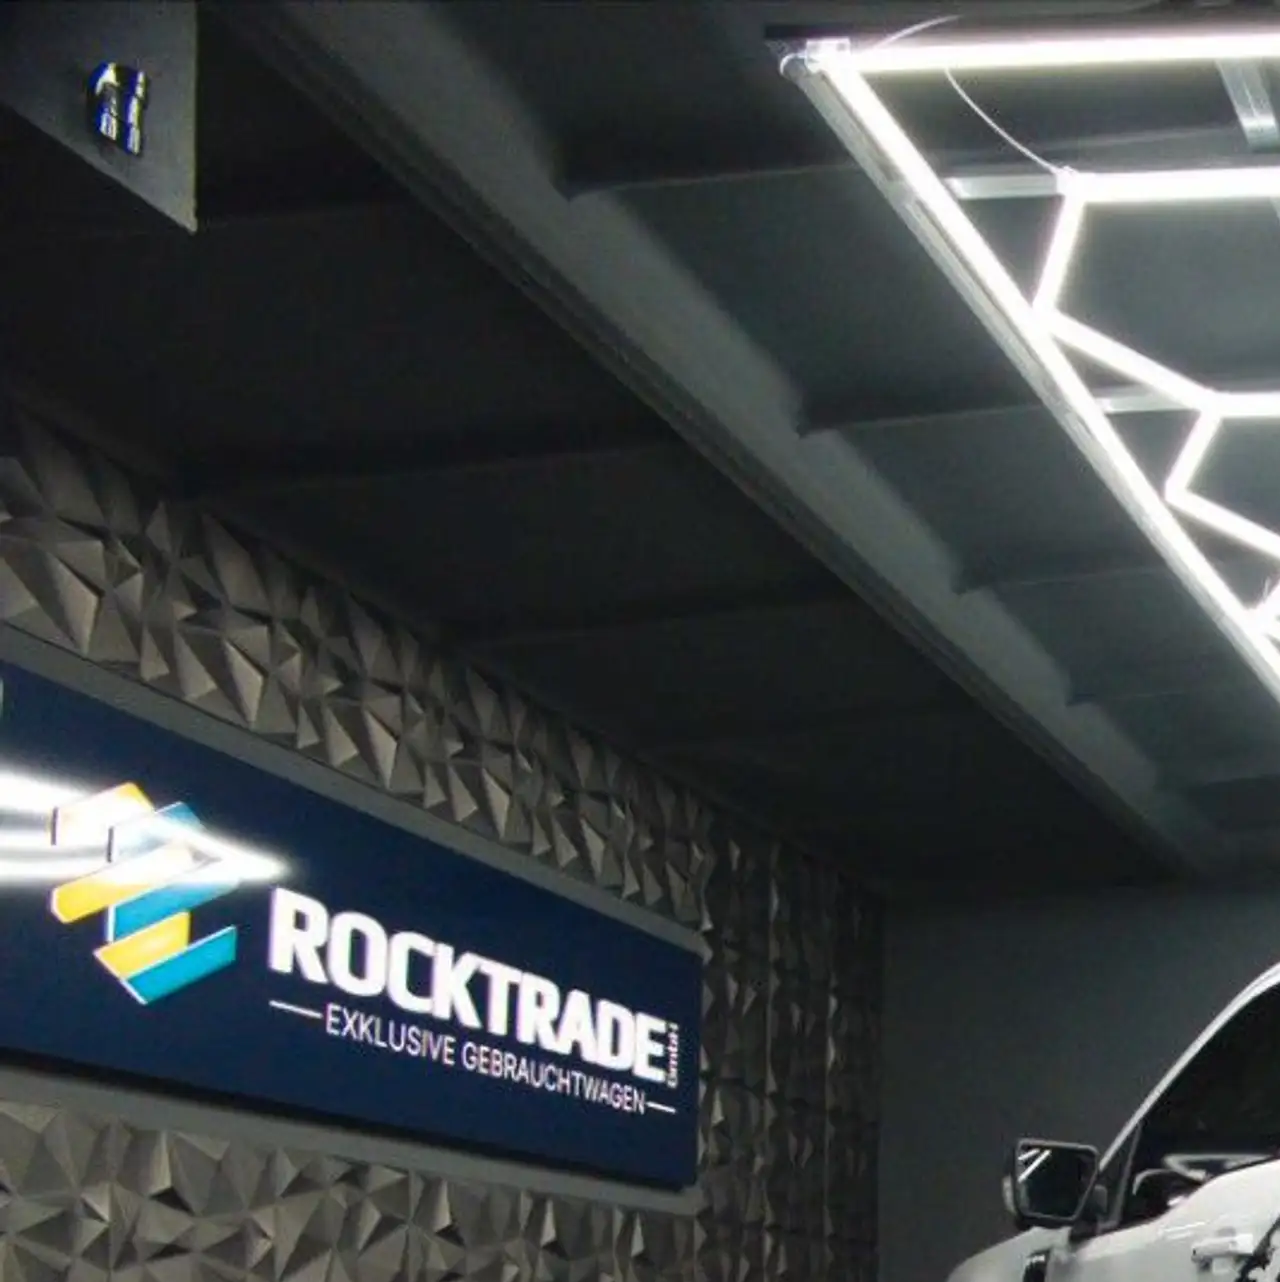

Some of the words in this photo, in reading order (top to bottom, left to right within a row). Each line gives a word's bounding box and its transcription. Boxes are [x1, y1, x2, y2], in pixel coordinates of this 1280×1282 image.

[269, 886, 667, 1084] ROCKTRADE
[325, 1002, 456, 1066] EXKLUSIVE
[461, 1041, 646, 1114] GEBRAUCHTWAGEN
